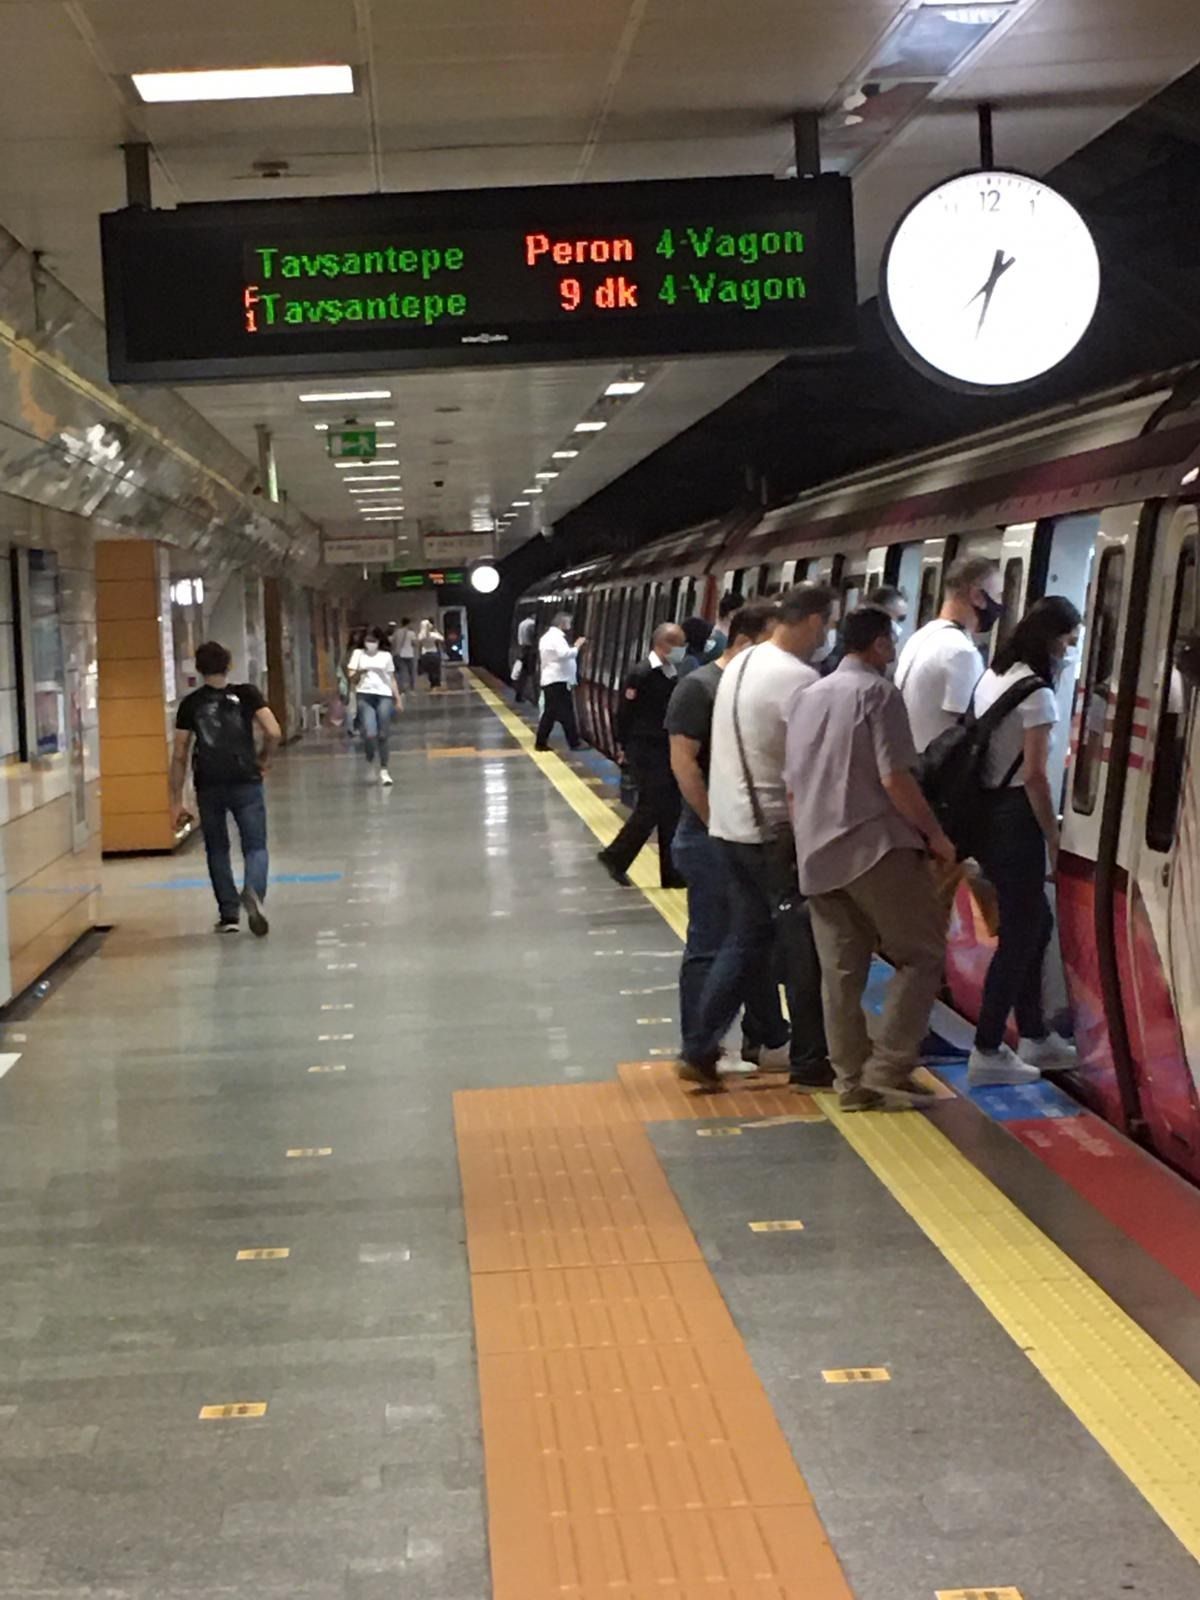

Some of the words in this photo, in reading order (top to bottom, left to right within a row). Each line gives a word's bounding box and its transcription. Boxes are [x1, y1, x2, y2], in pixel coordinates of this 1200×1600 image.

[979, 189, 1001, 212] 12
[256, 246, 465, 280] Tavşantepe
[525, 232, 634, 266] Peron
[258, 292, 467, 326] Tavşantepe
[559, 277, 582, 311] 9
[594, 276, 638, 309] dk
